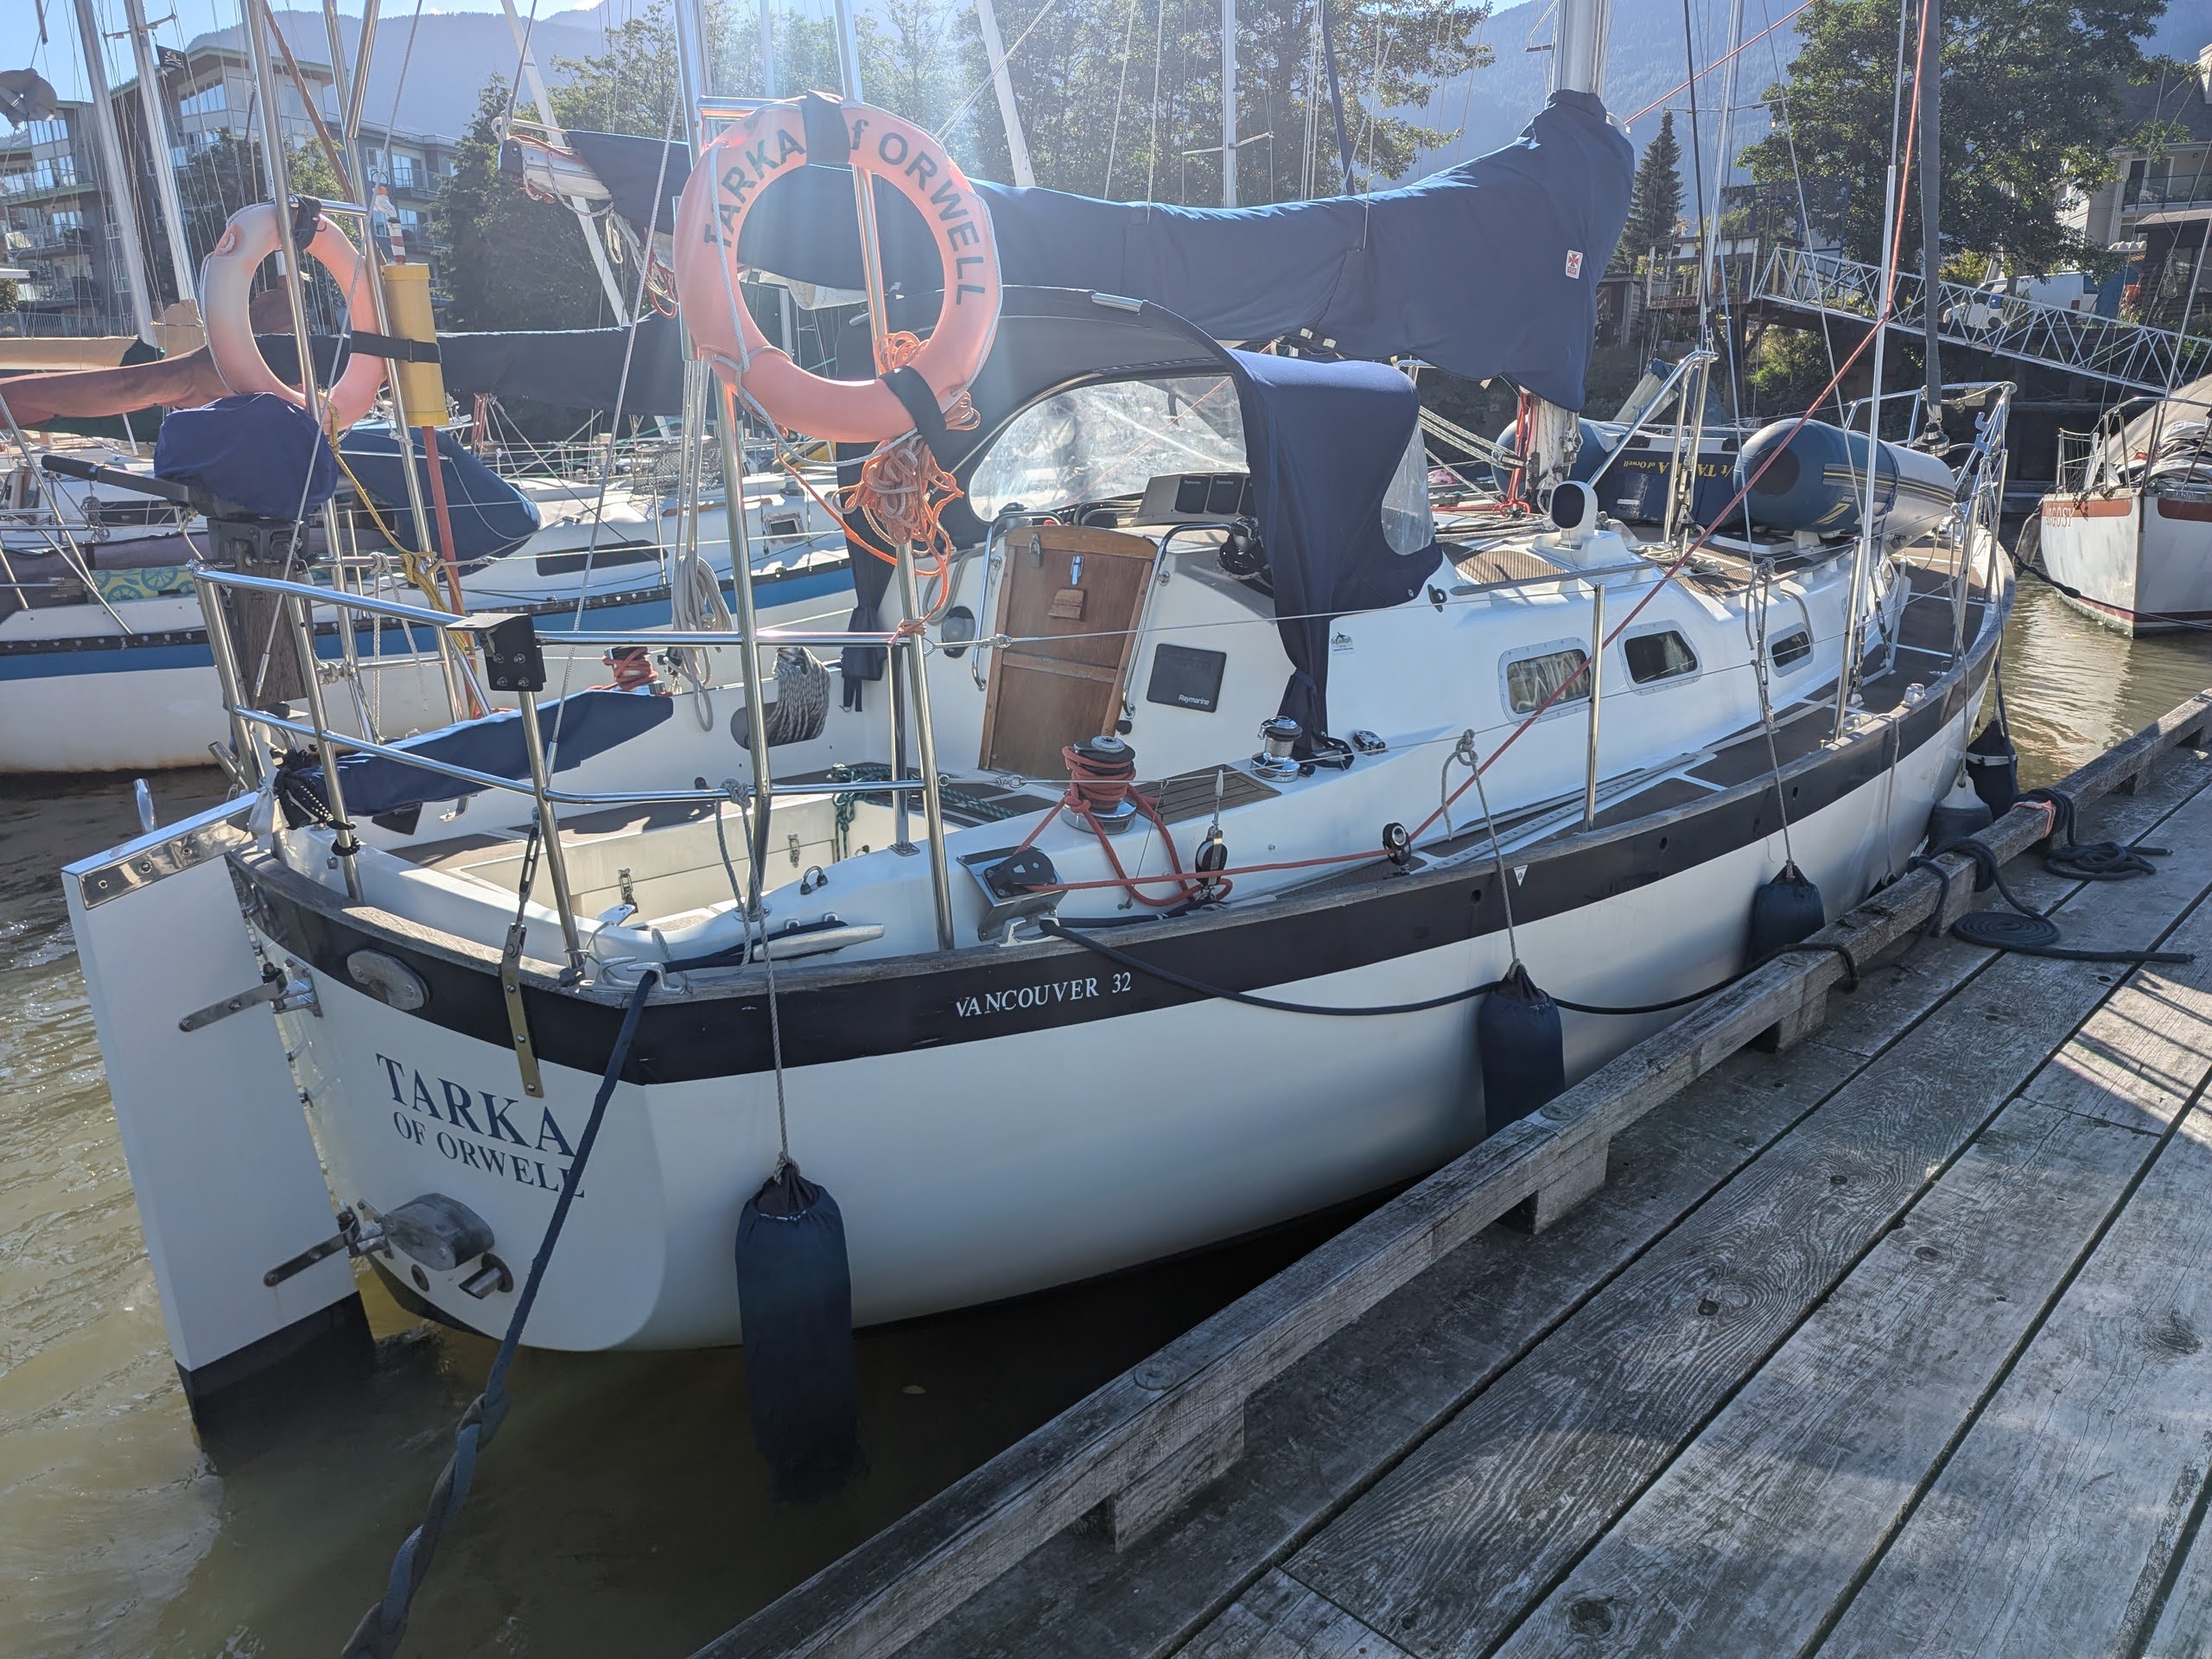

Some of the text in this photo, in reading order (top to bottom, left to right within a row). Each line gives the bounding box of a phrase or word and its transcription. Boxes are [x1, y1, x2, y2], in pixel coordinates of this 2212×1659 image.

[703, 118, 986, 305] TARKA f ORWELL
[1623, 460, 1647, 468] Orwell
[1658, 461, 1717, 477] TAA
[2044, 506, 2075, 528] ARGOSY
[1178, 694, 1210, 706] Raymarine
[956, 971, 1132, 1018] VANCOUVER 32
[375, 1052, 575, 1157] TARKA
[393, 1111, 426, 1147] OF
